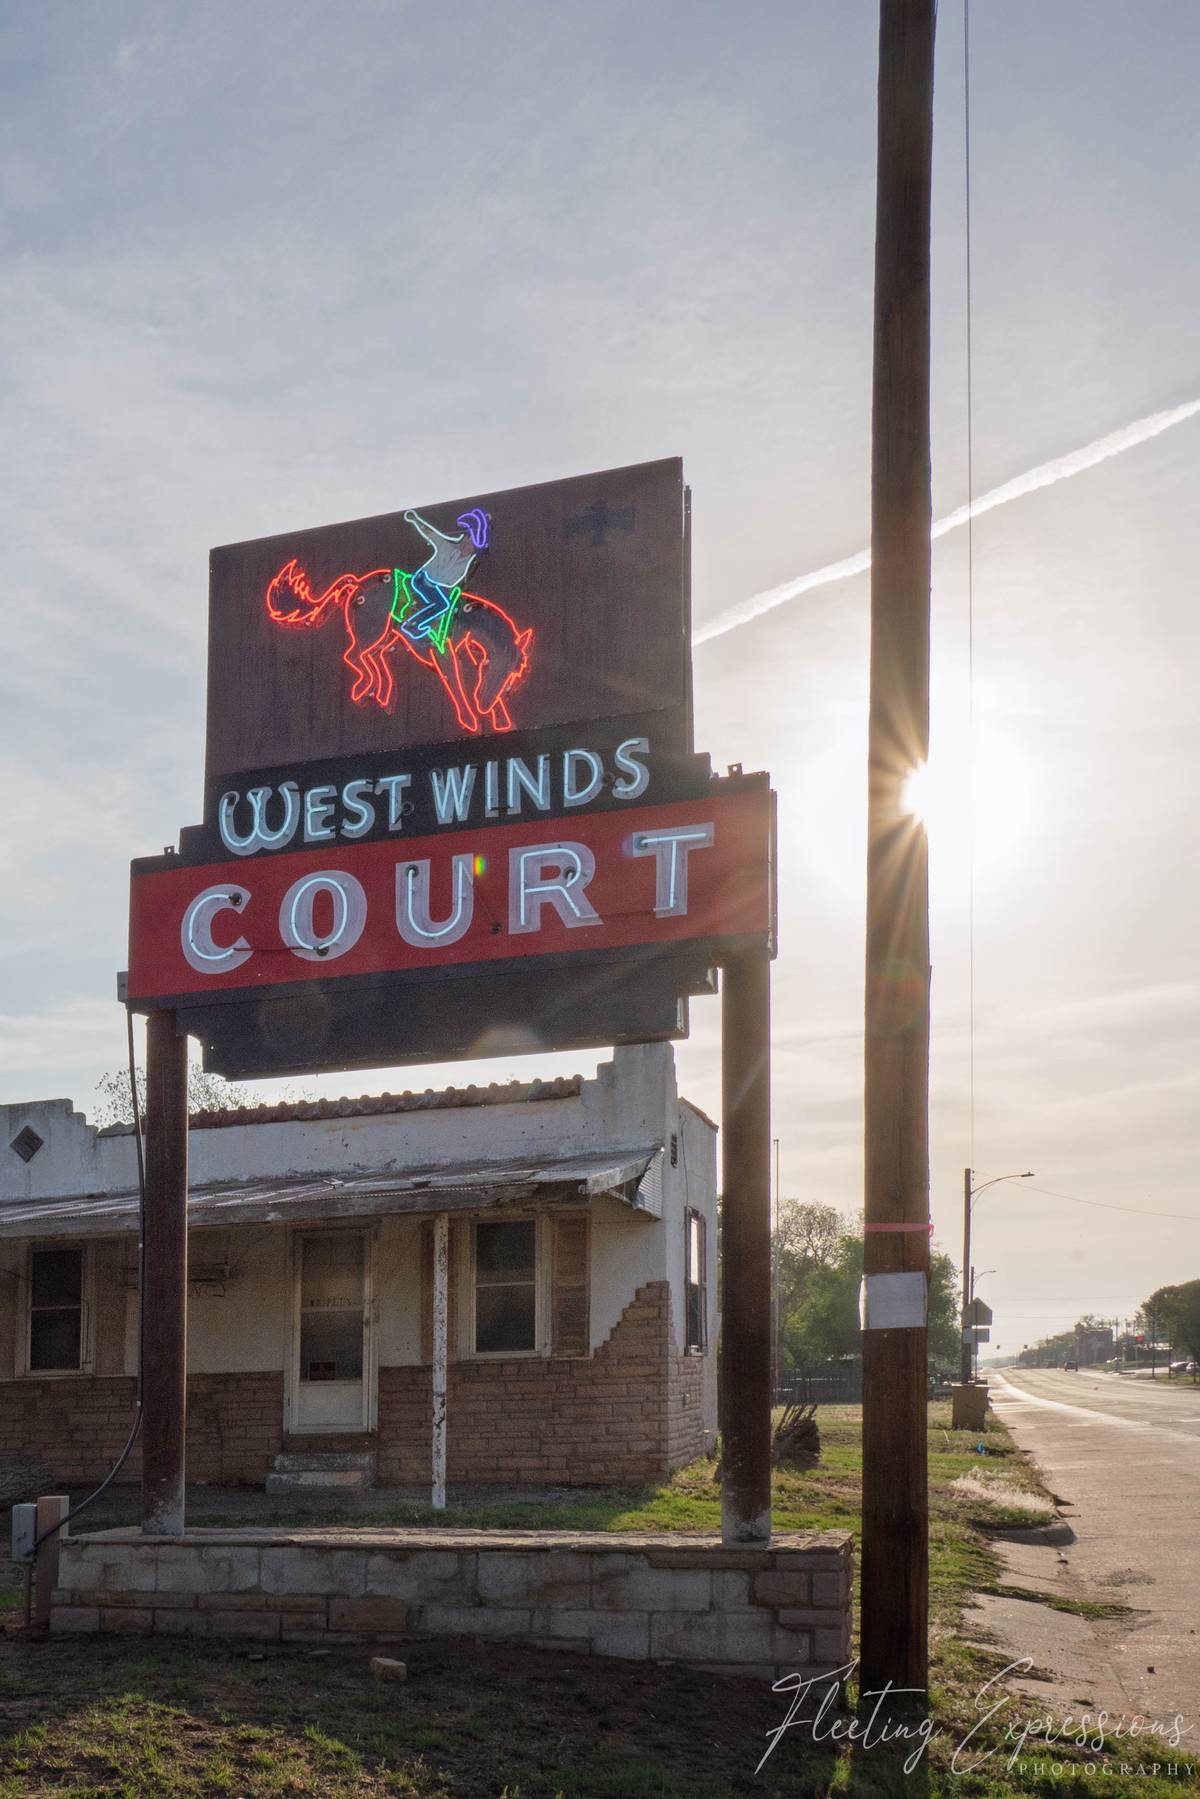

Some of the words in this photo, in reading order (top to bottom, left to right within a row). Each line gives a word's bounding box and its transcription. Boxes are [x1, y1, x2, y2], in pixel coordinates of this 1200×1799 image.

[219, 775, 412, 856] WEST
[432, 738, 650, 824] WINDS
[181, 823, 714, 974] COURT
